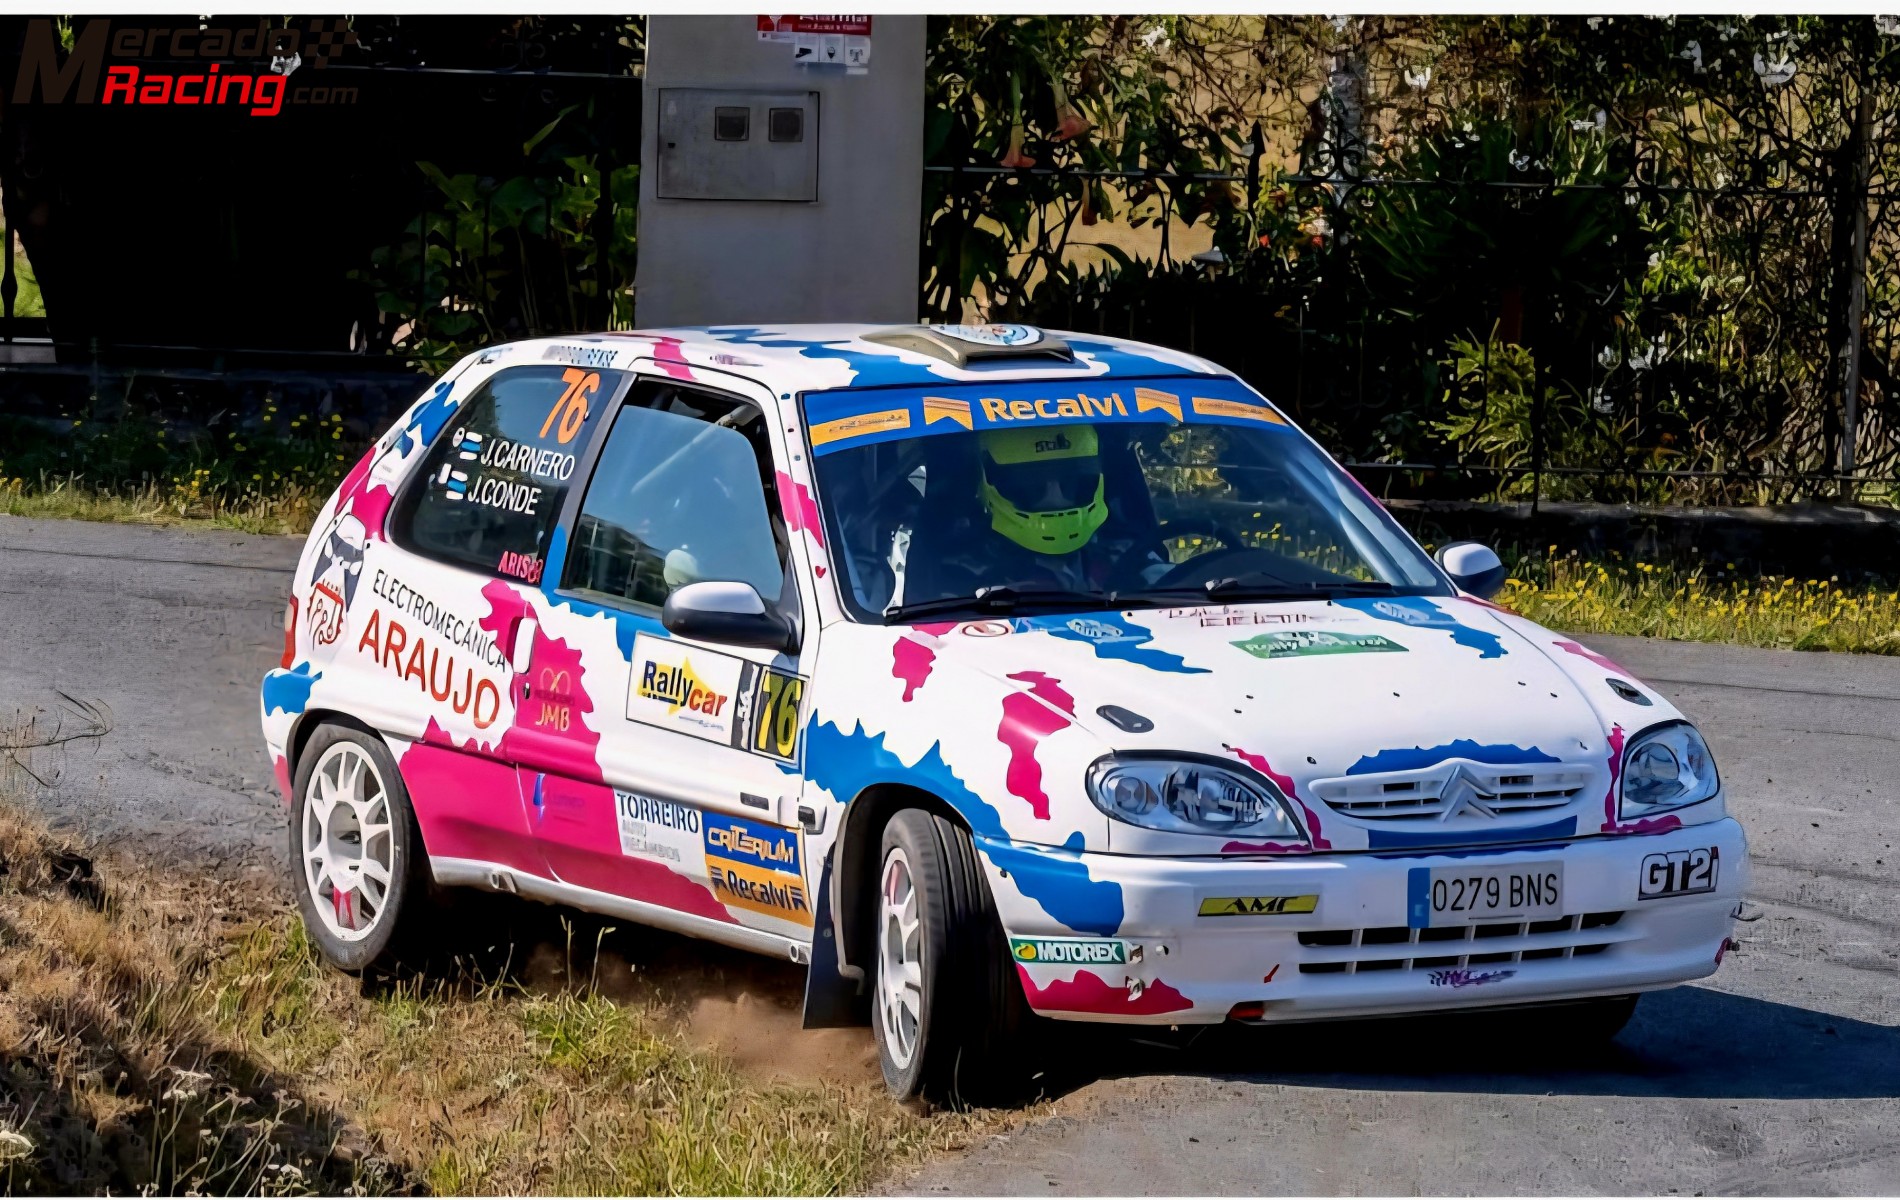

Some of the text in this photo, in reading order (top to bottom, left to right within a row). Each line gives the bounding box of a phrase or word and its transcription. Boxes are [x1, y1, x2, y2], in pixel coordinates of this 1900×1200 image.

[539, 368, 600, 444] 76
[480, 438, 576, 481] J.CARNERO
[467, 475, 542, 515] J.CONDE
[372, 568, 507, 673] ELECTROMECÁNICA
[358, 608, 500, 730] ARAUJO
[758, 672, 802, 757] 76
[617, 793, 700, 835] TORREIRO
[1432, 872, 1559, 913] 0279 BNS
[1037, 941, 1121, 962] MOTOREX
